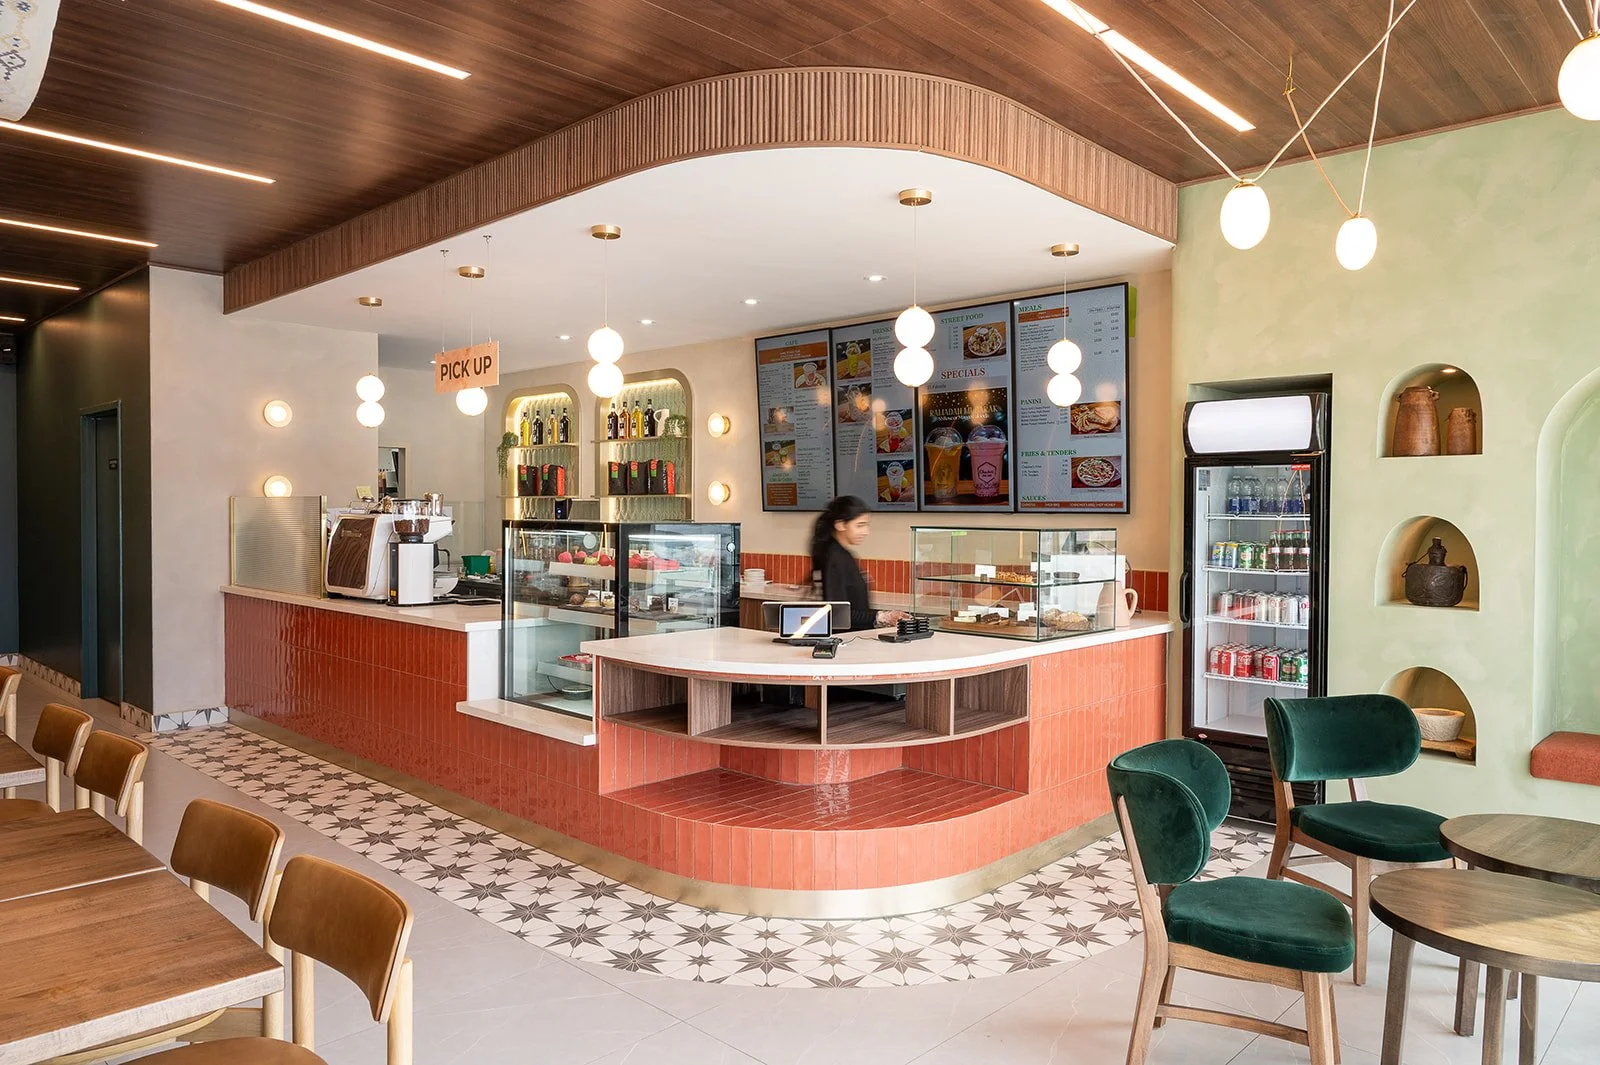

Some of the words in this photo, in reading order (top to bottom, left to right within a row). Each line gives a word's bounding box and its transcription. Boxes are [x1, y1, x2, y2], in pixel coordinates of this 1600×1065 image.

[1019, 304, 1042, 313] MEALS
[941, 316, 963, 325] STREET
[441, 360, 470, 381] PICK
[474, 356, 492, 376] UP
[941, 367, 986, 380] SPECIALS
[1021, 398, 1042, 406] PANINI
